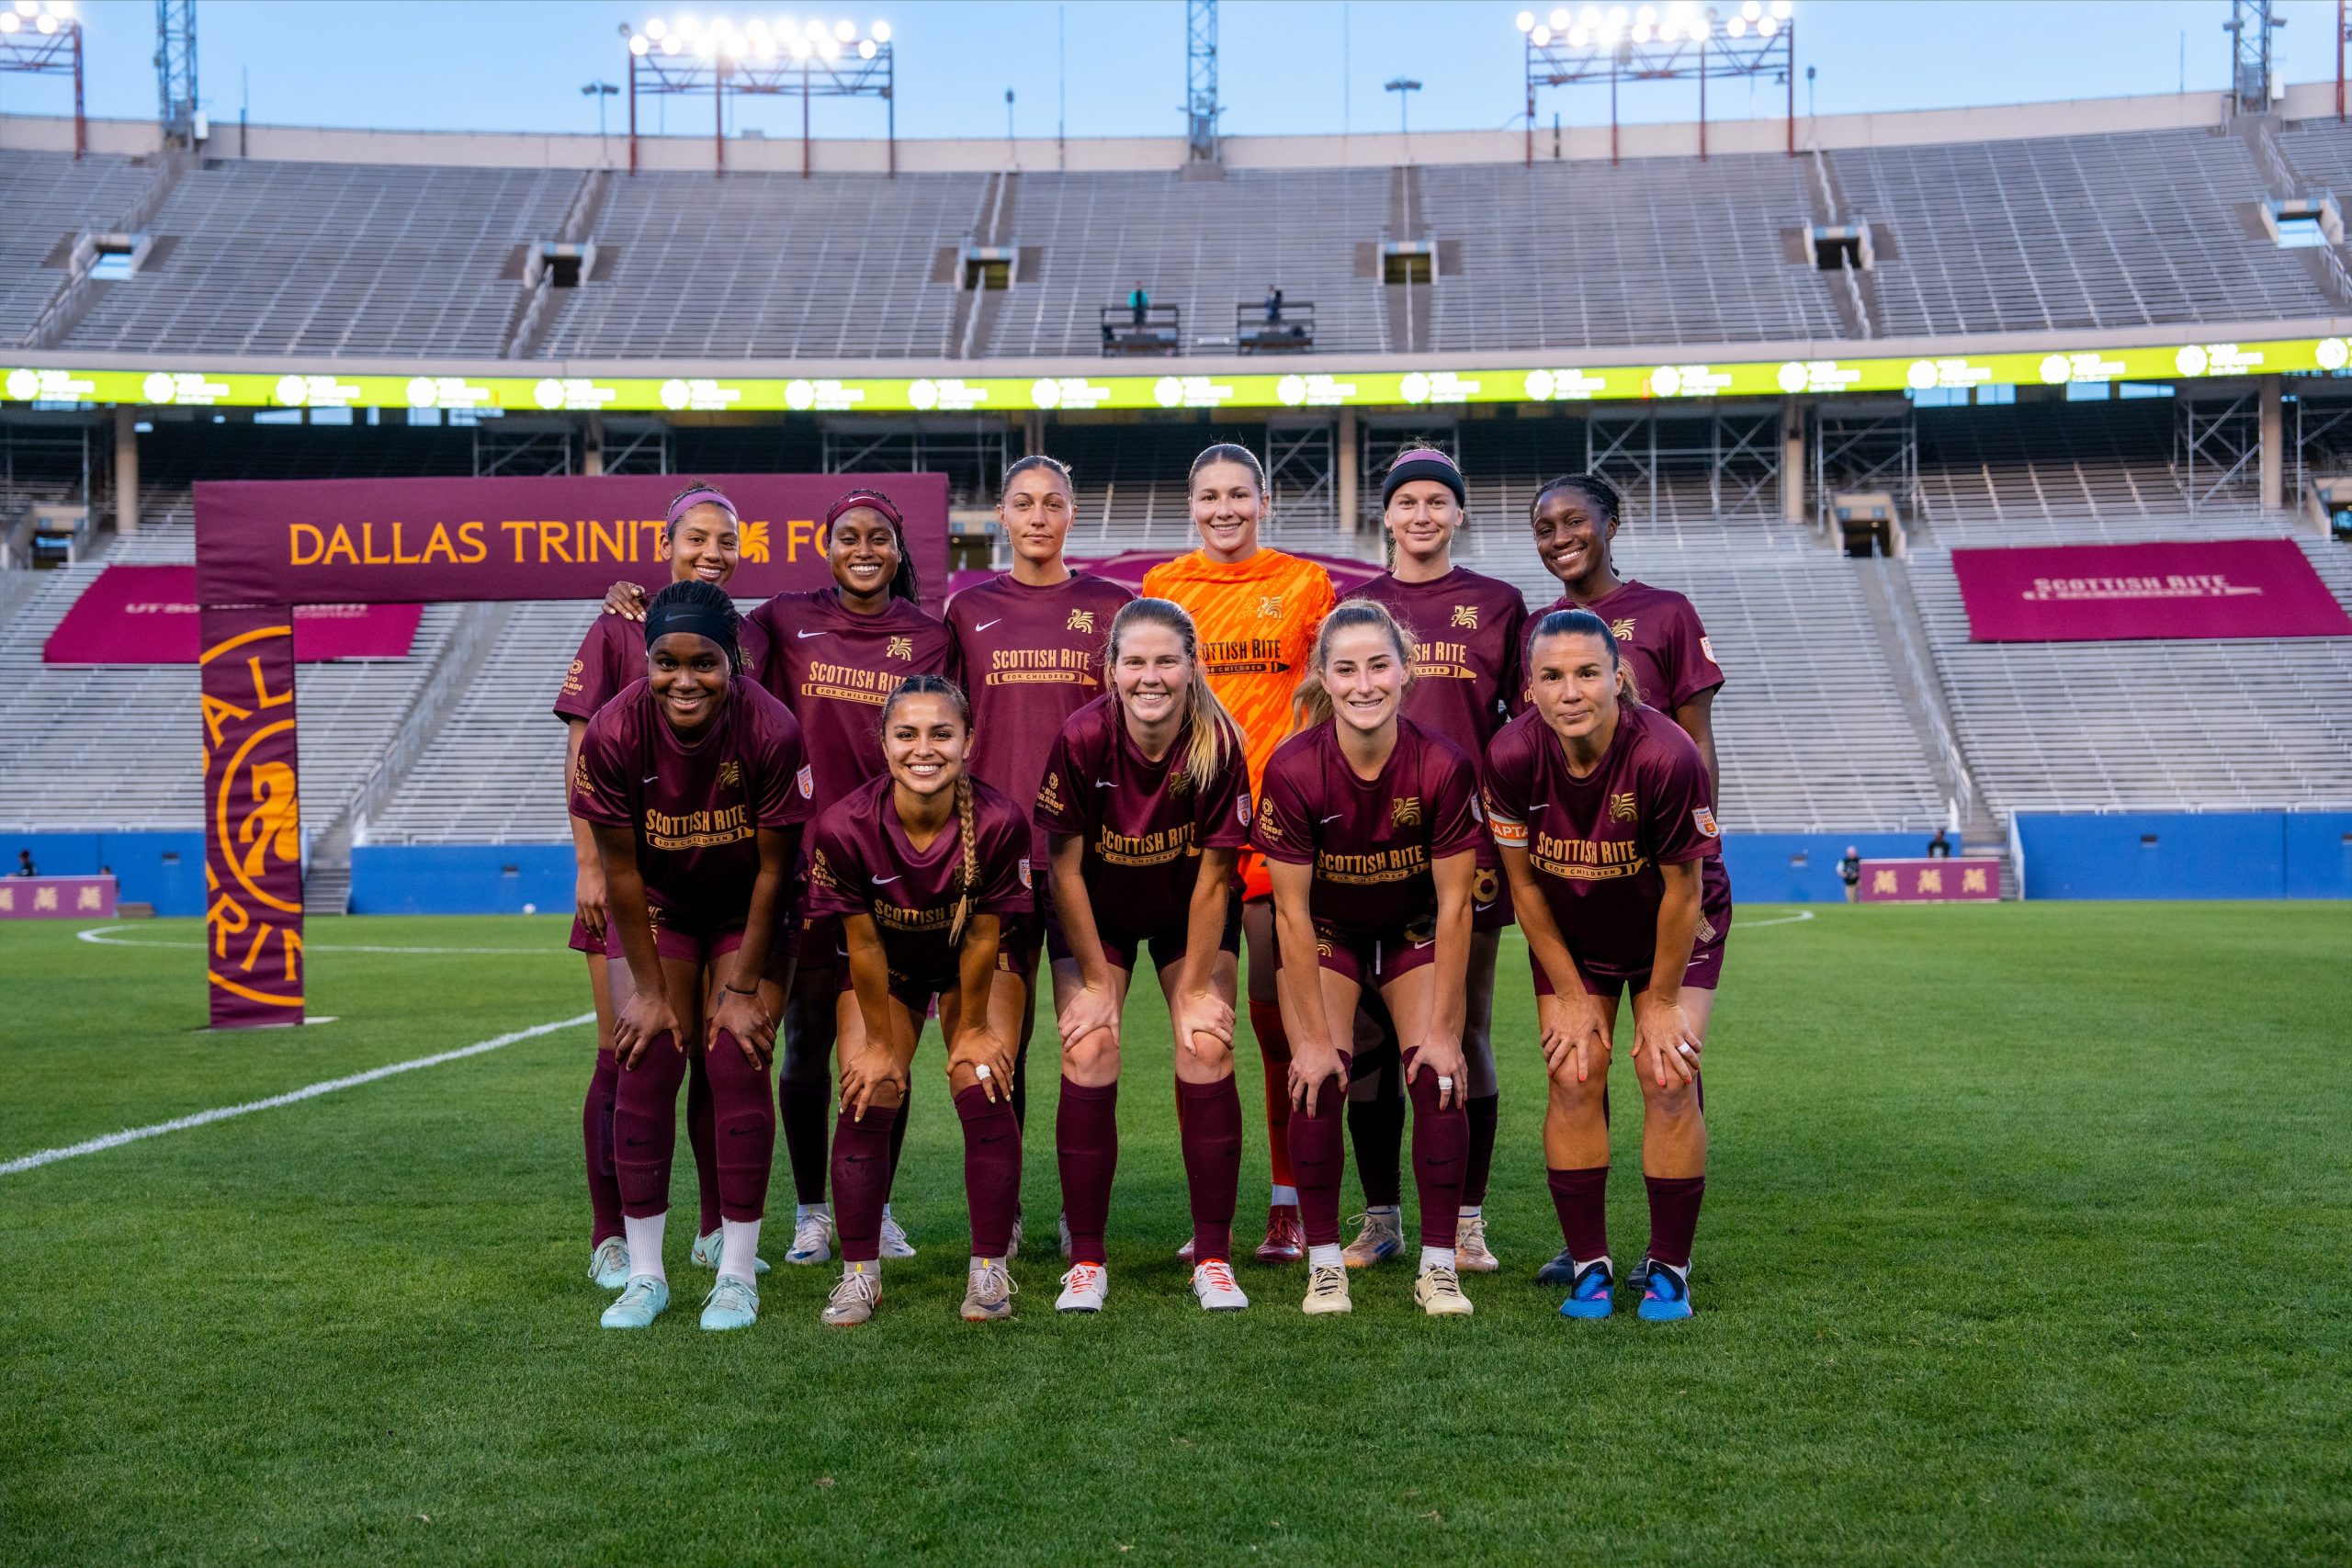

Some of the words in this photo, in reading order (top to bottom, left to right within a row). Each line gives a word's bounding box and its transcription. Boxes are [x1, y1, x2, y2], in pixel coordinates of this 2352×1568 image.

[289, 521, 487, 565] DALLAS
[501, 520, 669, 563] TRINIT
[2033, 576, 2161, 592] SCOTTISH
[2165, 574, 2230, 590] RITE
[992, 649, 1057, 670] SCOTTISH
[1060, 648, 1091, 671] RITE
[1202, 641, 1248, 661] OTTISH
[1251, 638, 1281, 660] RITE
[1434, 641, 1466, 663] RITE
[808, 660, 876, 690] SCOTTISH
[877, 671, 908, 693] RIT
[1025, 672, 1070, 681] CHILDREN
[820, 688, 837, 696] FOR
[840, 692, 887, 704] CHILDREN
[1044, 787, 1057, 799] RIO
[645, 808, 711, 836] SCOTTISH
[714, 804, 747, 831] RITE
[680, 834, 729, 846] CHILDREN
[1537, 830, 1598, 864] SCOTTISH
[1600, 840, 1637, 864] RITE
[1317, 848, 1387, 874] SCOTTISH
[1389, 845, 1424, 869] RITE
[1549, 864, 1566, 874] FOR
[1570, 868, 1616, 876] CHILDREN
[874, 898, 945, 925] SCOTTISH
